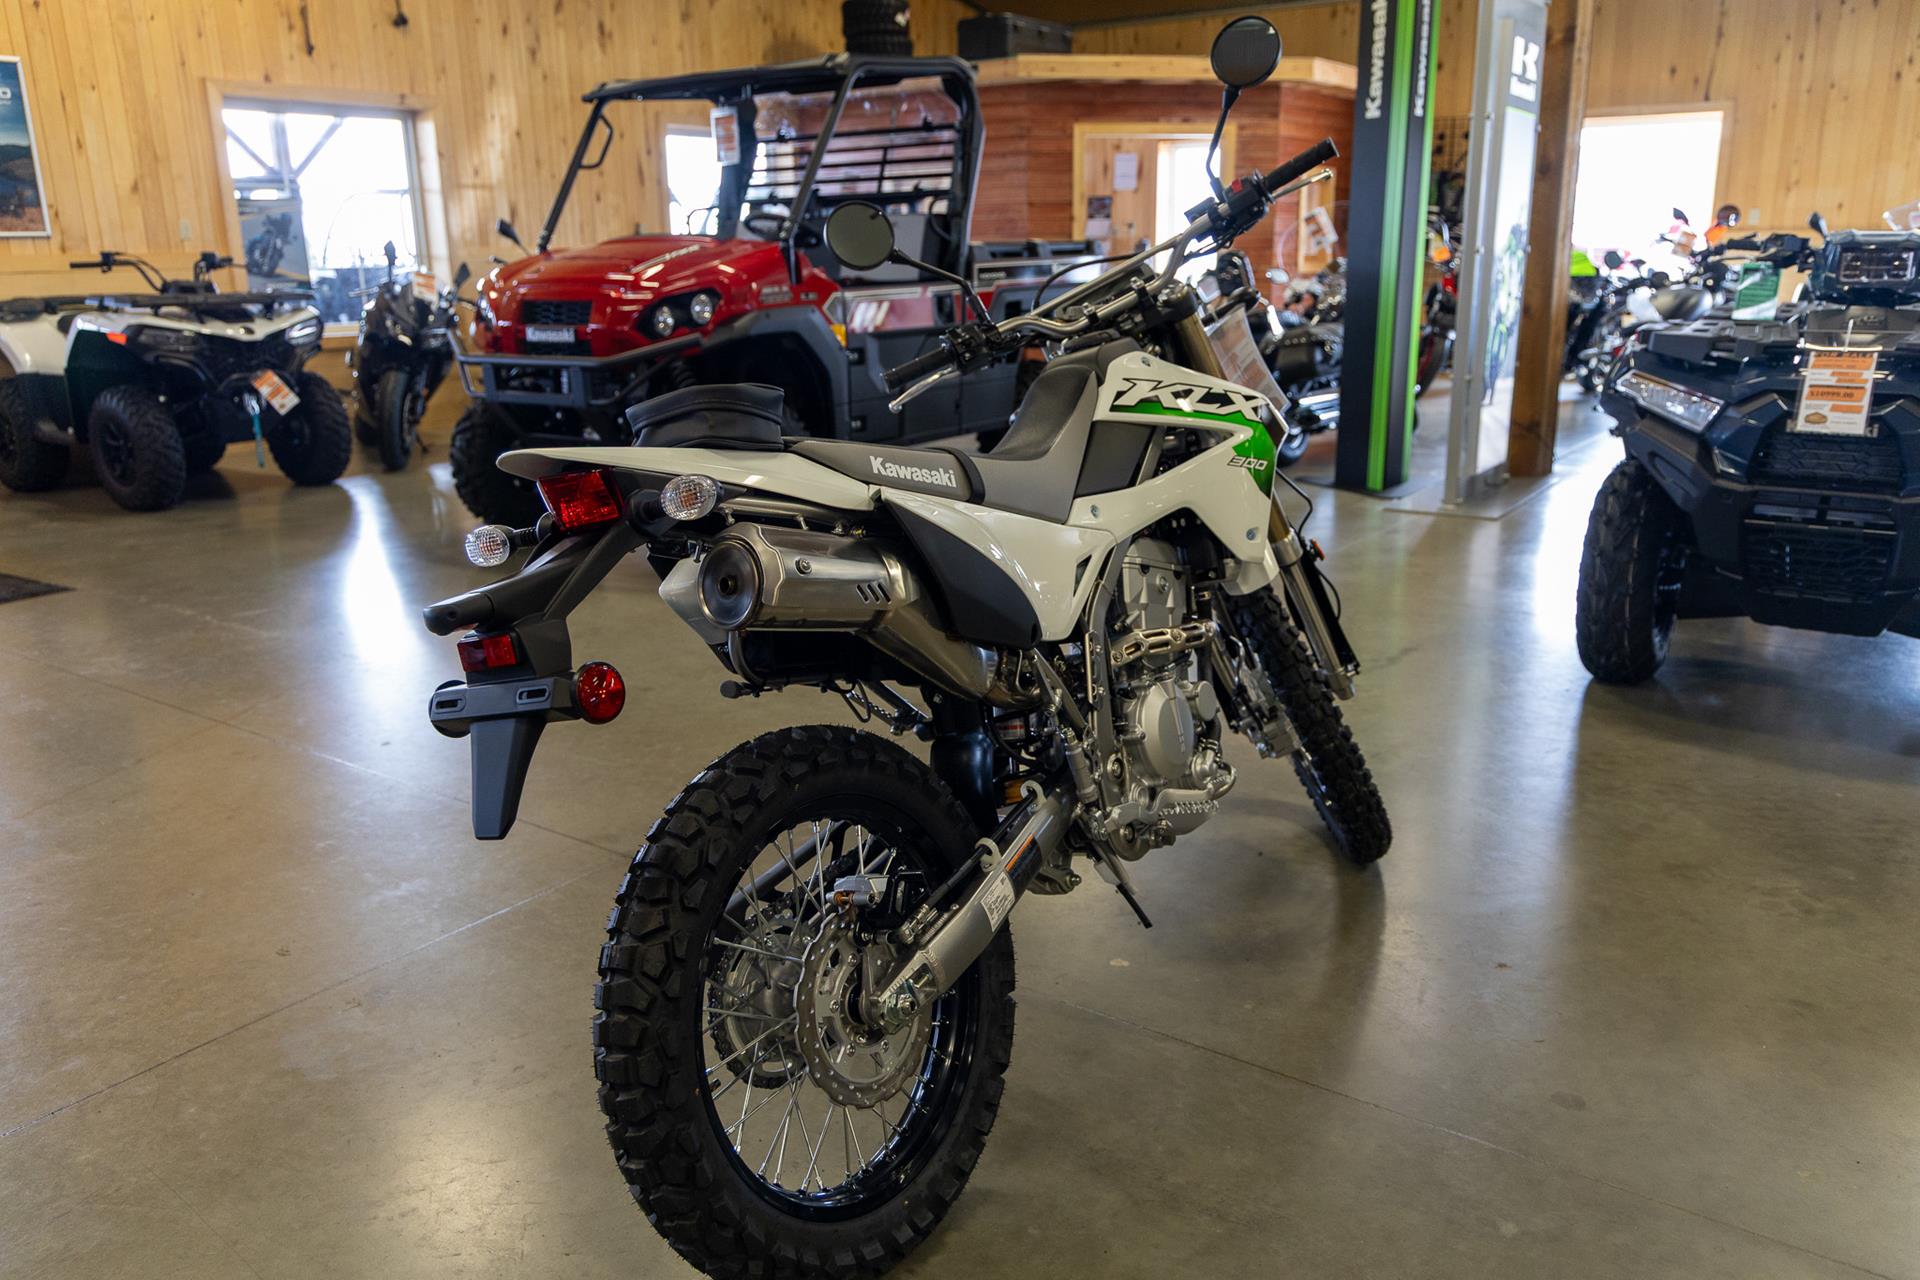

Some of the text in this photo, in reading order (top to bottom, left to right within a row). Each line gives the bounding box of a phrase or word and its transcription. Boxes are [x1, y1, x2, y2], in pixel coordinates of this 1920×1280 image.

[1113, 378, 1271, 423] KLX
[869, 455, 957, 488] Kawasaki
[1227, 456, 1269, 471] 300
